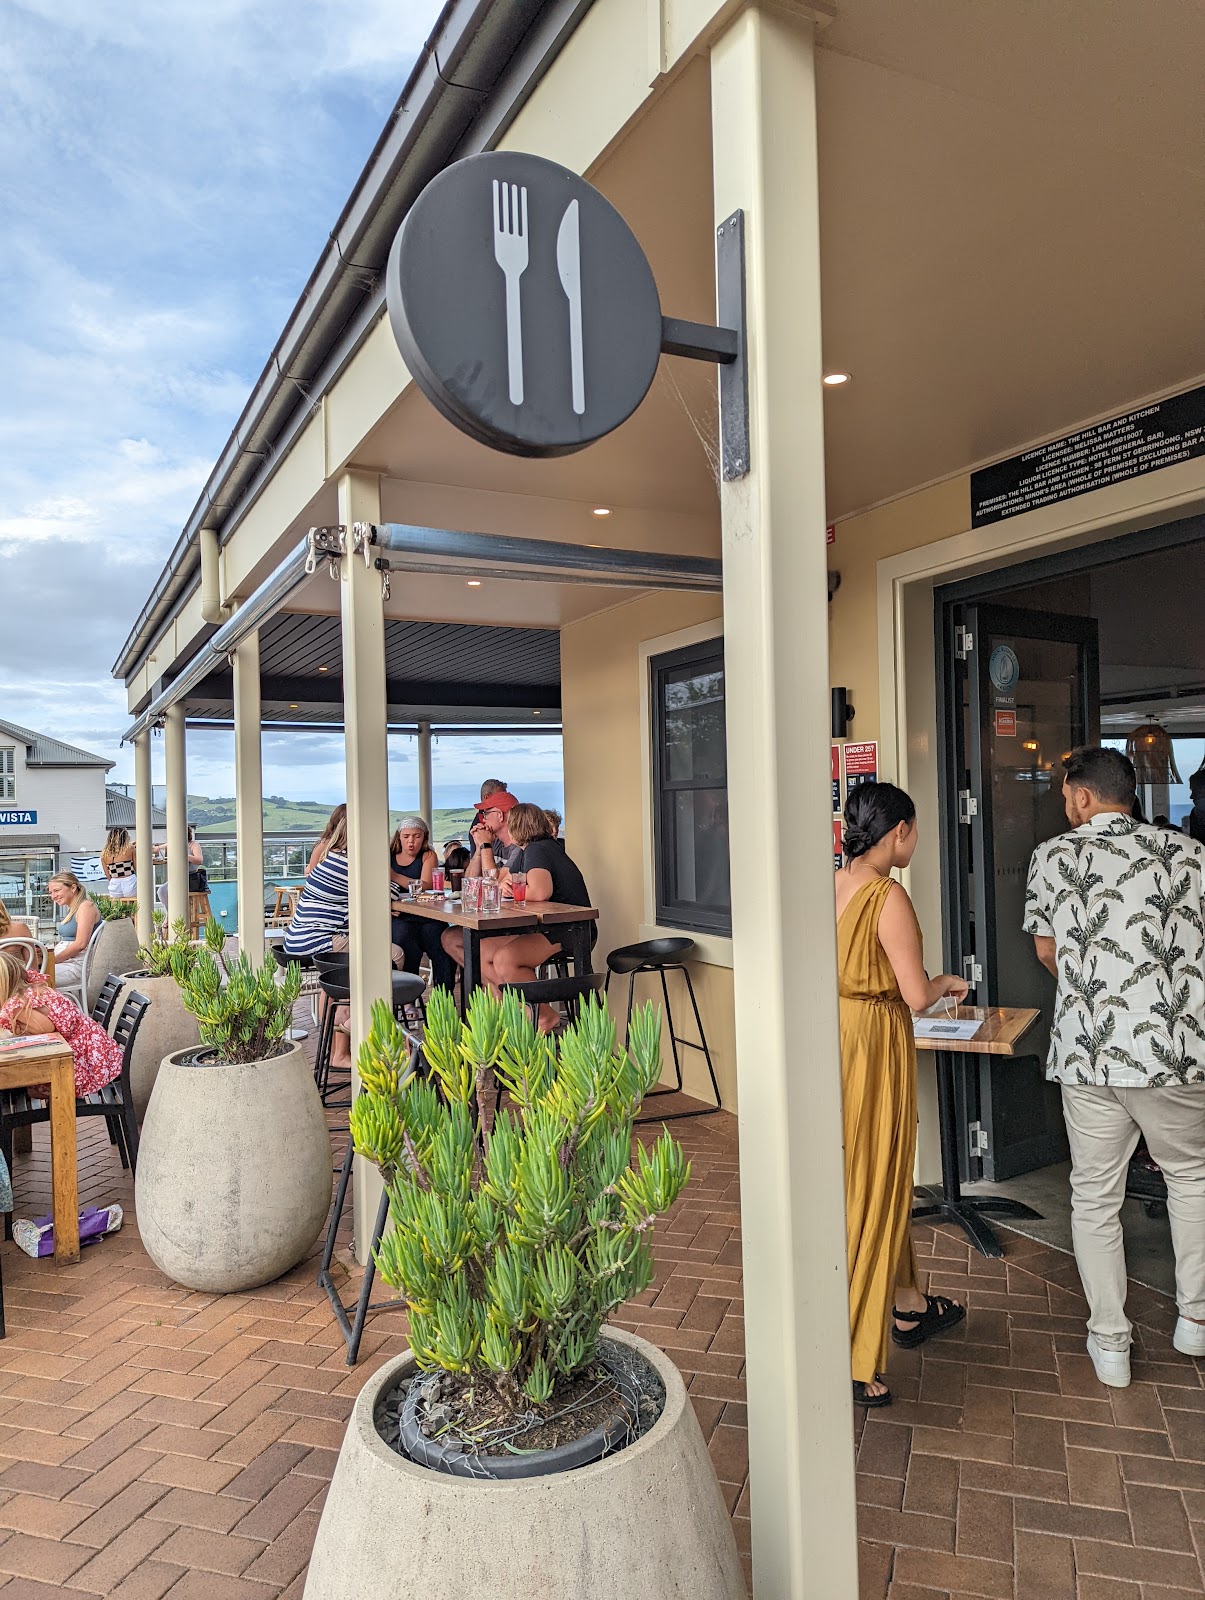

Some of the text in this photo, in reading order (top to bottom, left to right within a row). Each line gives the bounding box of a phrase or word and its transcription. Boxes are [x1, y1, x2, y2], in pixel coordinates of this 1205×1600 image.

[1022, 406, 1160, 461] LICENCE NAME: THE HILL BAR AND KITCHEN
[1042, 424, 1135, 462] LICENSEE: MELISSA MATTERS
[976, 496, 1024, 516] AUTHORISATIONS:
[1024, 487, 1049, 500] MINOR'S
[1050, 483, 1066, 495] AREA
[1067, 473, 1092, 487] (WHOLE
[1093, 470, 1102, 478] OF
[1103, 459, 1137, 474] PREMISES
[1139, 444, 1180, 462] EXCLUDING
[1181, 438, 1197, 449] BAR
[979, 494, 1007, 507] PREMISES:
[1008, 488, 1019, 498] THE
[1020, 485, 1033, 495] HILL
[1034, 480, 1046, 489] BAR
[1048, 476, 1060, 485] AND
[1061, 466, 1089, 480] KITCHEN
[1103, 455, 1121, 466] FERN
[1122, 451, 1132, 459] ST
[1133, 434, 1183, 453] GERRINGONG,
[1185, 426, 1202, 438] NSW
[1019, 431, 1165, 486] LIQUOR LICENCE TYPE: HOTEL (GENERAL BAR)
[1036, 459, 1060, 472] LICENCE
[1062, 448, 1090, 463] NUMBER:
[1001, 502, 1030, 516] EXTENDED
[1031, 493, 1057, 506] TRADING
[1059, 475, 1110, 497] AUTHORISATION
[1111, 466, 1138, 481] (WHOLE
[1150, 450, 1190, 467] PREMISES)
[995, 696, 1014, 704] FINALIST
[845, 744, 875, 754] UNDER 25?
[0, 812, 32, 823] VISTA
